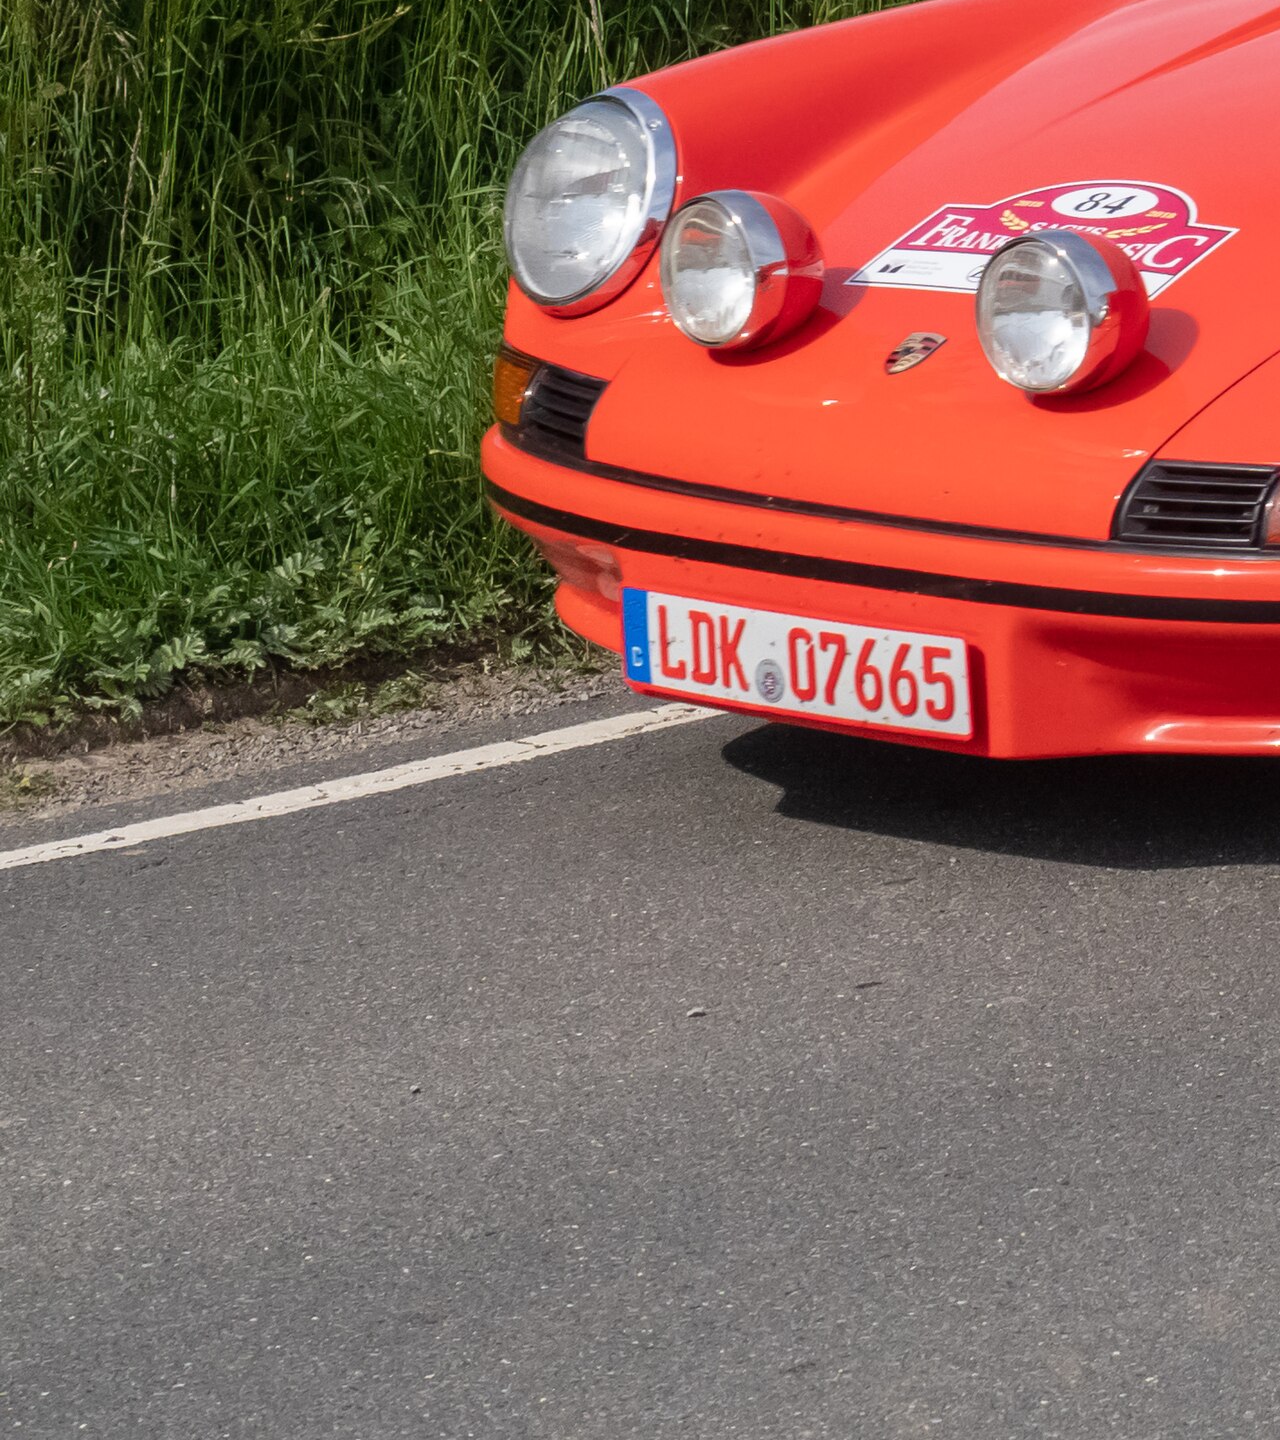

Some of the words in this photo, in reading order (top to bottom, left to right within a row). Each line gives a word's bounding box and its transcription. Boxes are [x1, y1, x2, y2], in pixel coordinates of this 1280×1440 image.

[1074, 192, 1137, 215] 84
[907, 213, 1014, 251] FRANK
[657, 604, 750, 692] LDK
[787, 626, 956, 722] 07665
